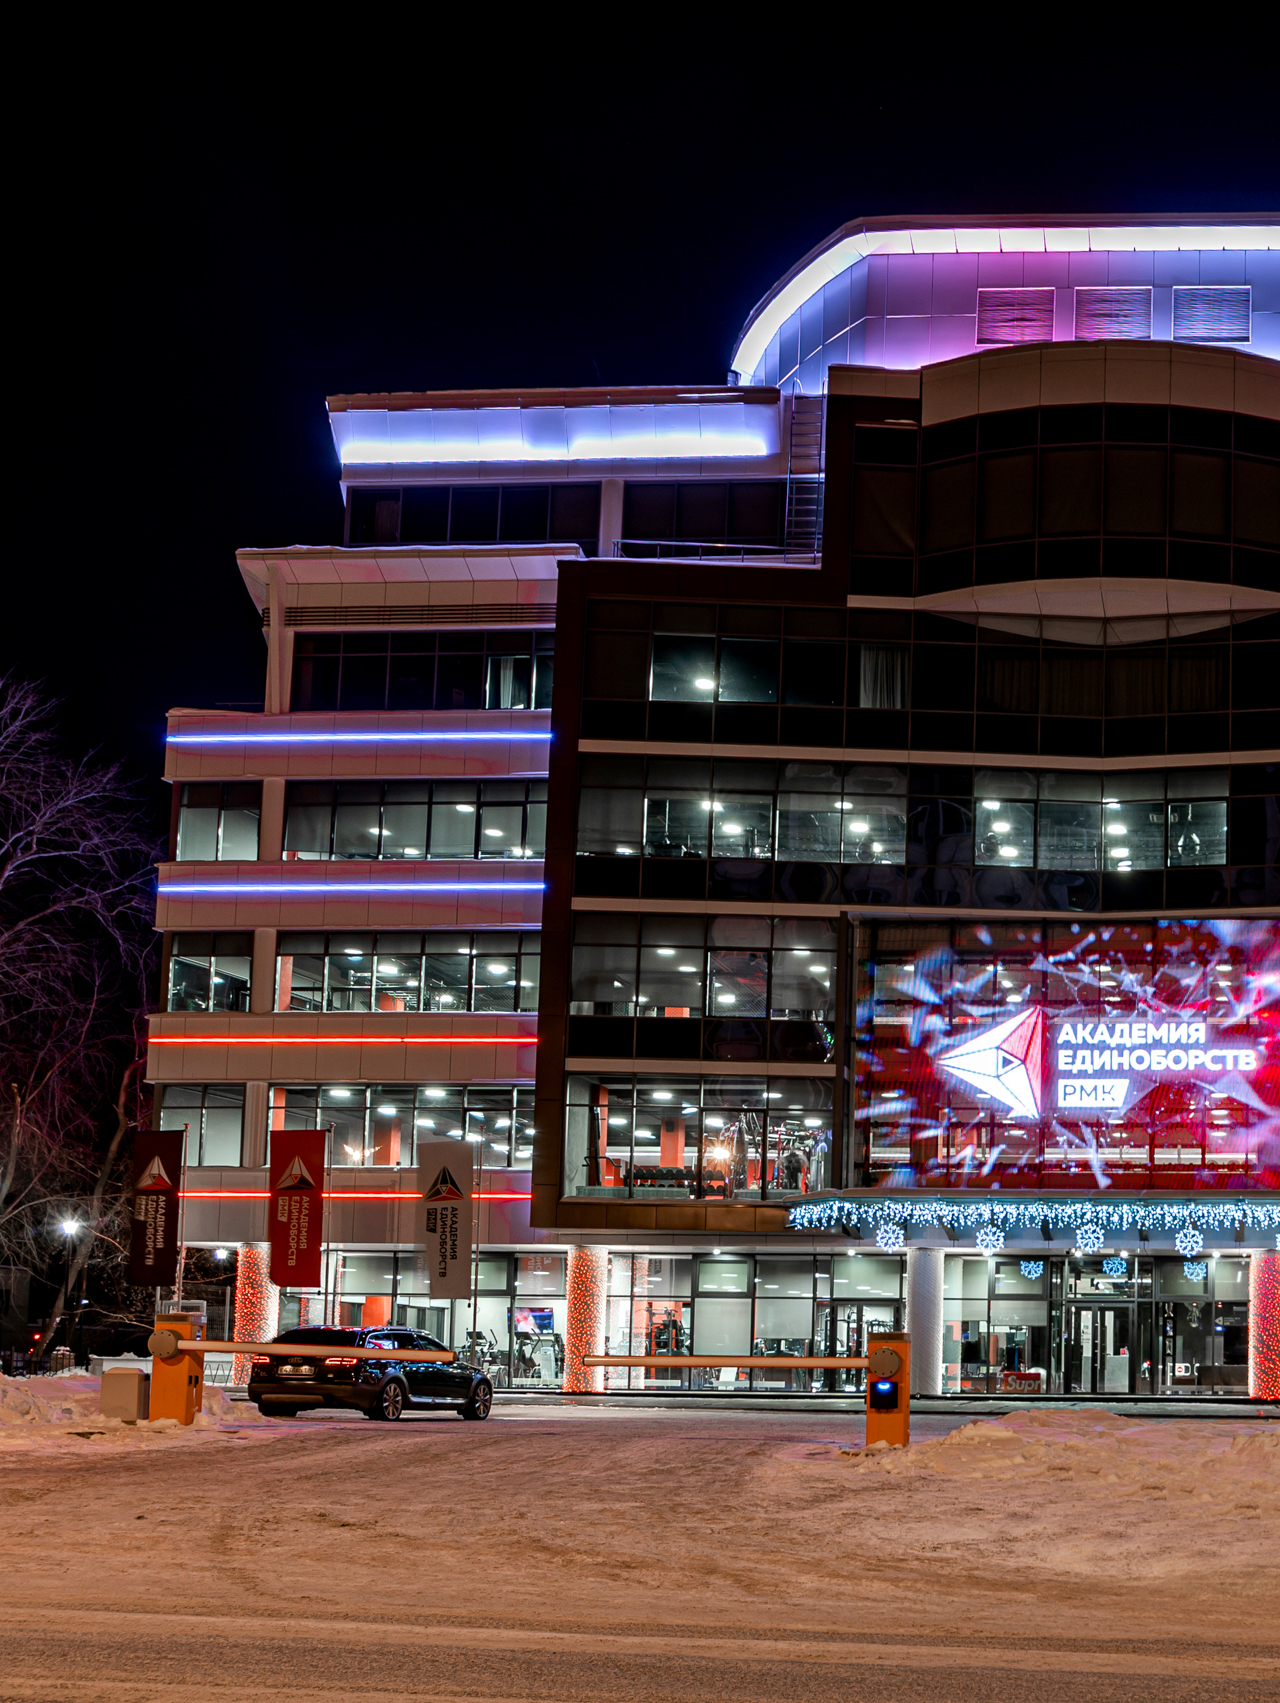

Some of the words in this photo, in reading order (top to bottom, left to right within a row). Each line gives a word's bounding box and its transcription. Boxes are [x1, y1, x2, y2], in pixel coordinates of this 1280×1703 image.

[1057, 1022, 1206, 1047] АКАДЕМИЯ
[1058, 1049, 1258, 1074] ЕДИНОБОРСТВ
[1062, 1084, 1116, 1101] РМК
[155, 1195, 166, 1248] АКАДЕМИЯ
[288, 1196, 300, 1266] ЕДИНОБОРСТВ
[299, 1196, 310, 1249] АКАДЕМИЯ
[438, 1206, 448, 1278] ЕДИНОБОРСТВ
[449, 1206, 458, 1260] АКАДЕМИЯ
[1007, 1375, 1040, 1392] Supr
